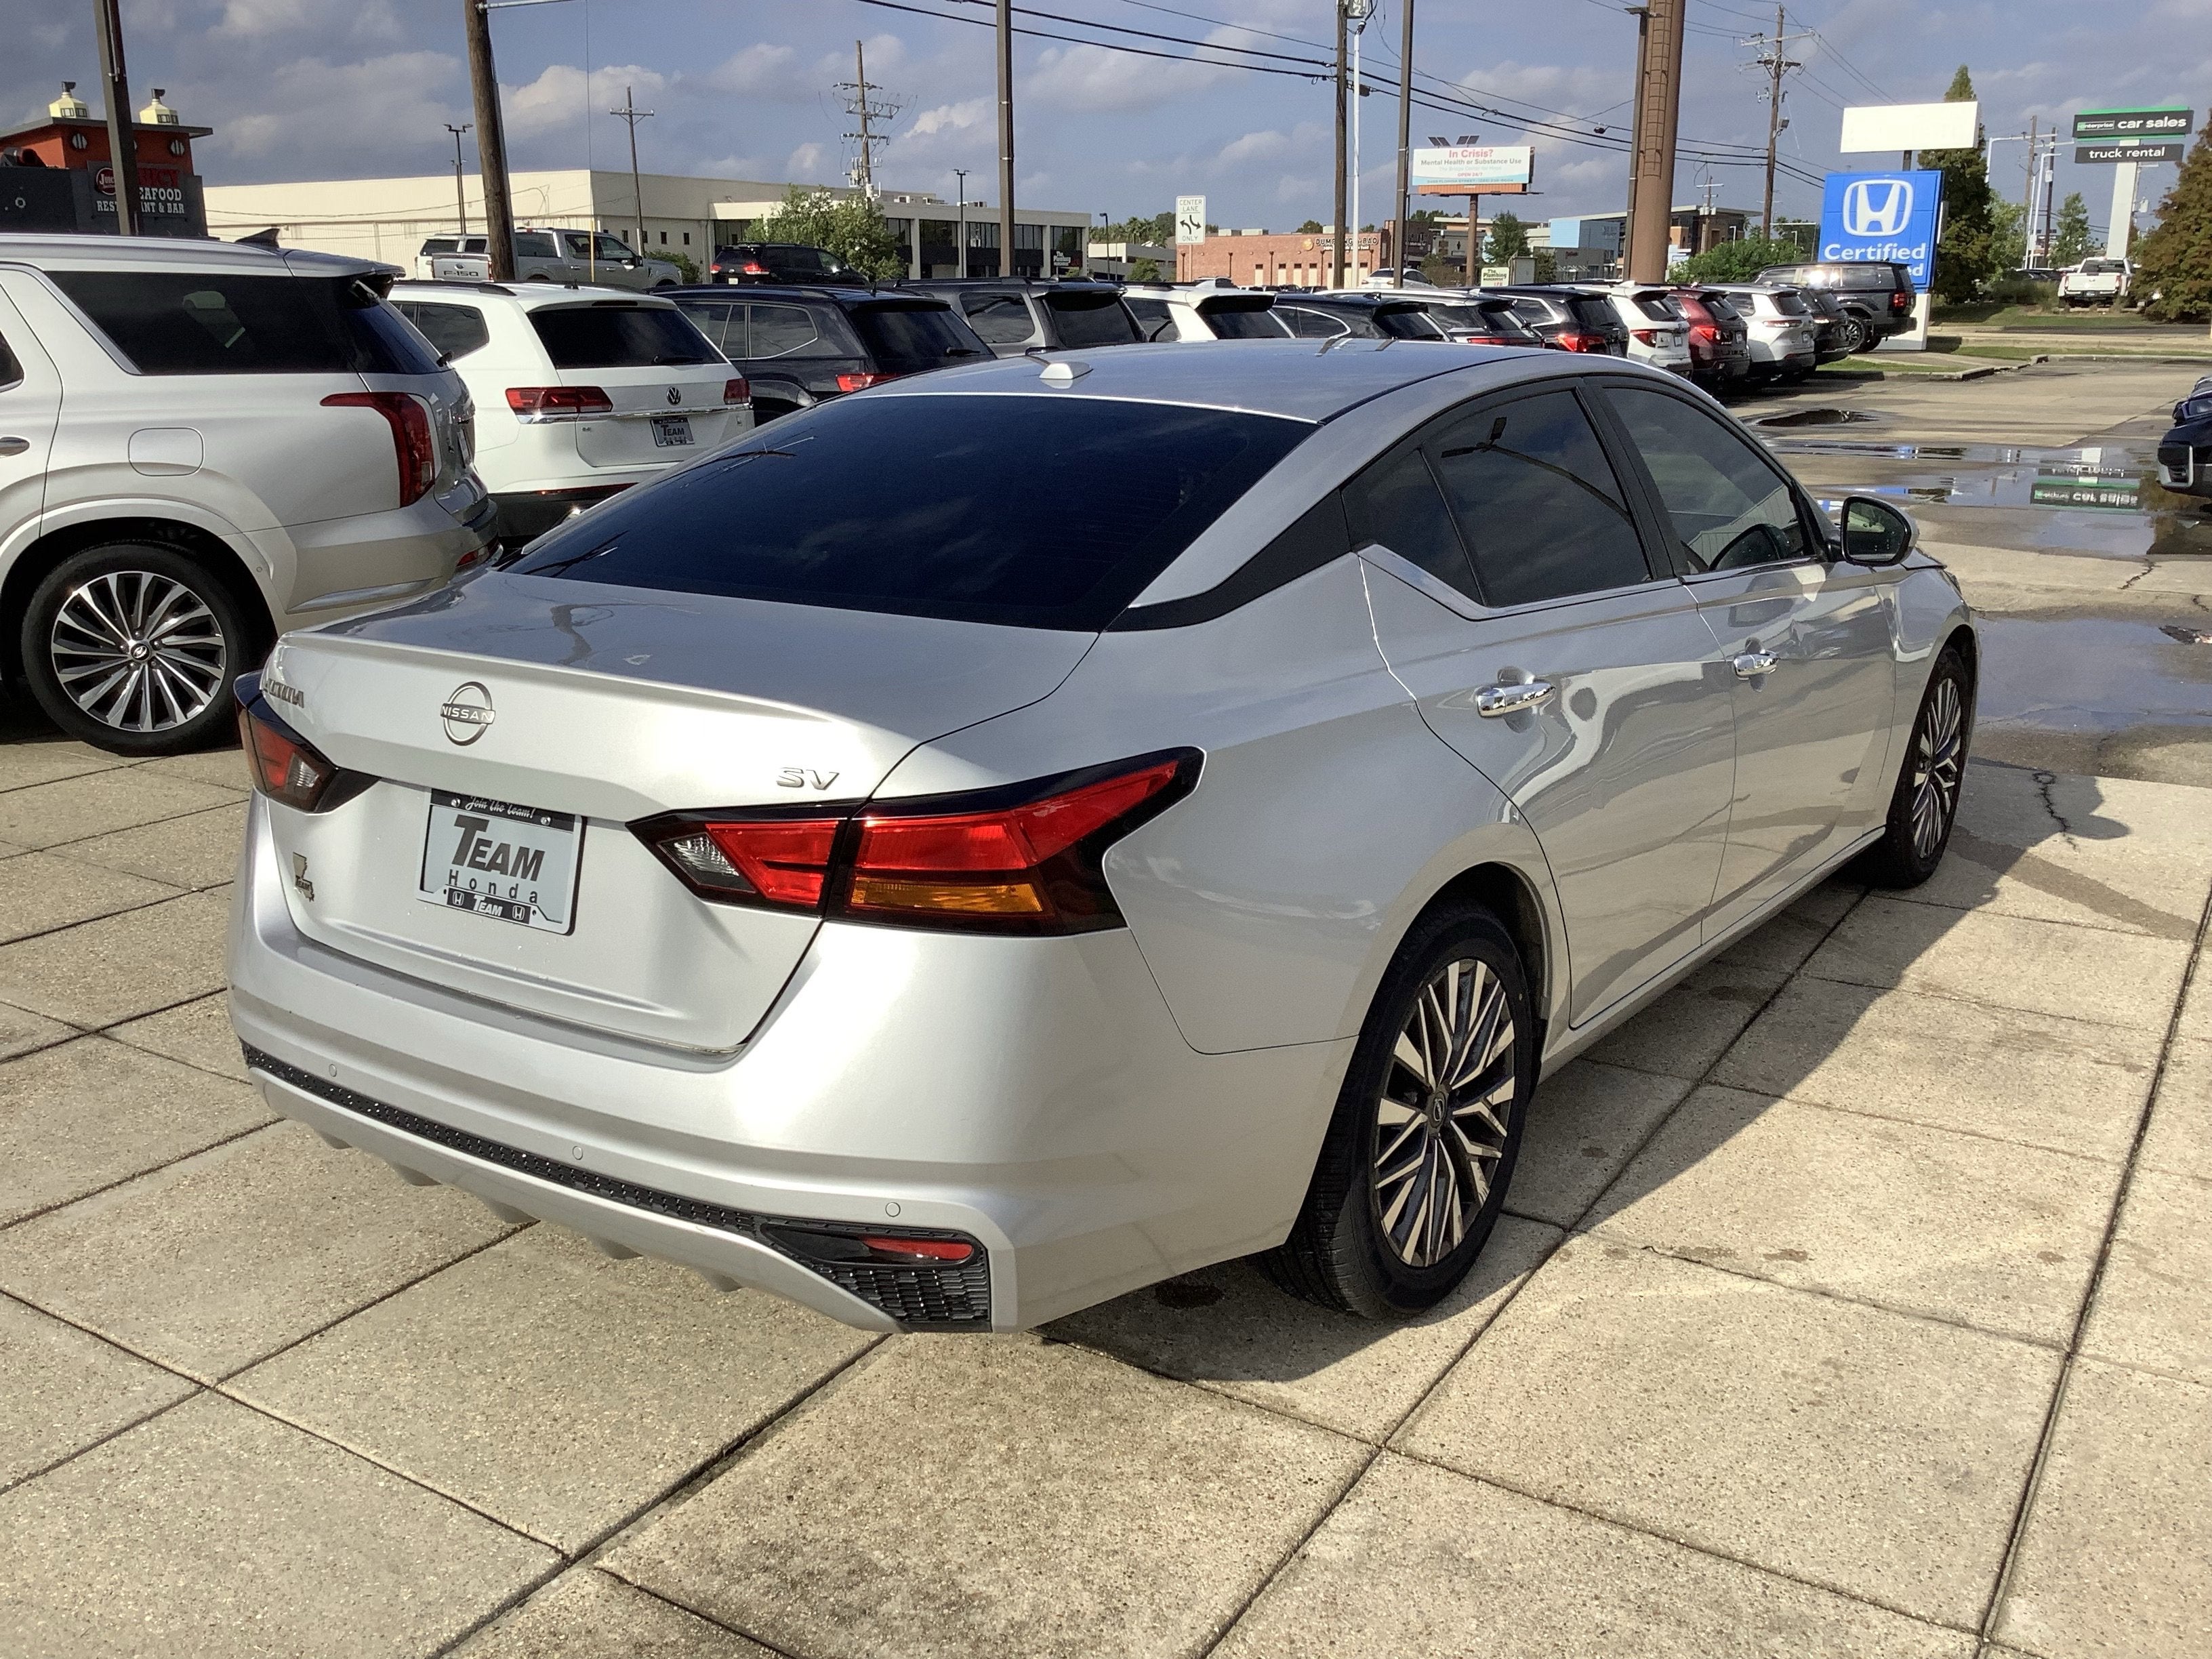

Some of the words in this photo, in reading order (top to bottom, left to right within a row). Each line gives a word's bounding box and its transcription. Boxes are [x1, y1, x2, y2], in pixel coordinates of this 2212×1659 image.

[2117, 119, 2144, 129] car
[2146, 116, 2187, 128] sales
[1449, 150, 1458, 158] In
[1461, 149, 1494, 158] Crisis?
[2089, 148, 2123, 159] truck
[2126, 146, 2165, 157] rental
[139, 187, 182, 201] EAFOOD
[158, 203, 165, 213] &
[167, 203, 185, 213] BAR
[1824, 243, 1926, 260] Certified
[442, 705, 494, 723] NISSAN
[775, 766, 840, 791] SV
[451, 814, 546, 882] TEAM
[448, 869, 539, 904] Honda
[472, 895, 504, 917] TEAM
